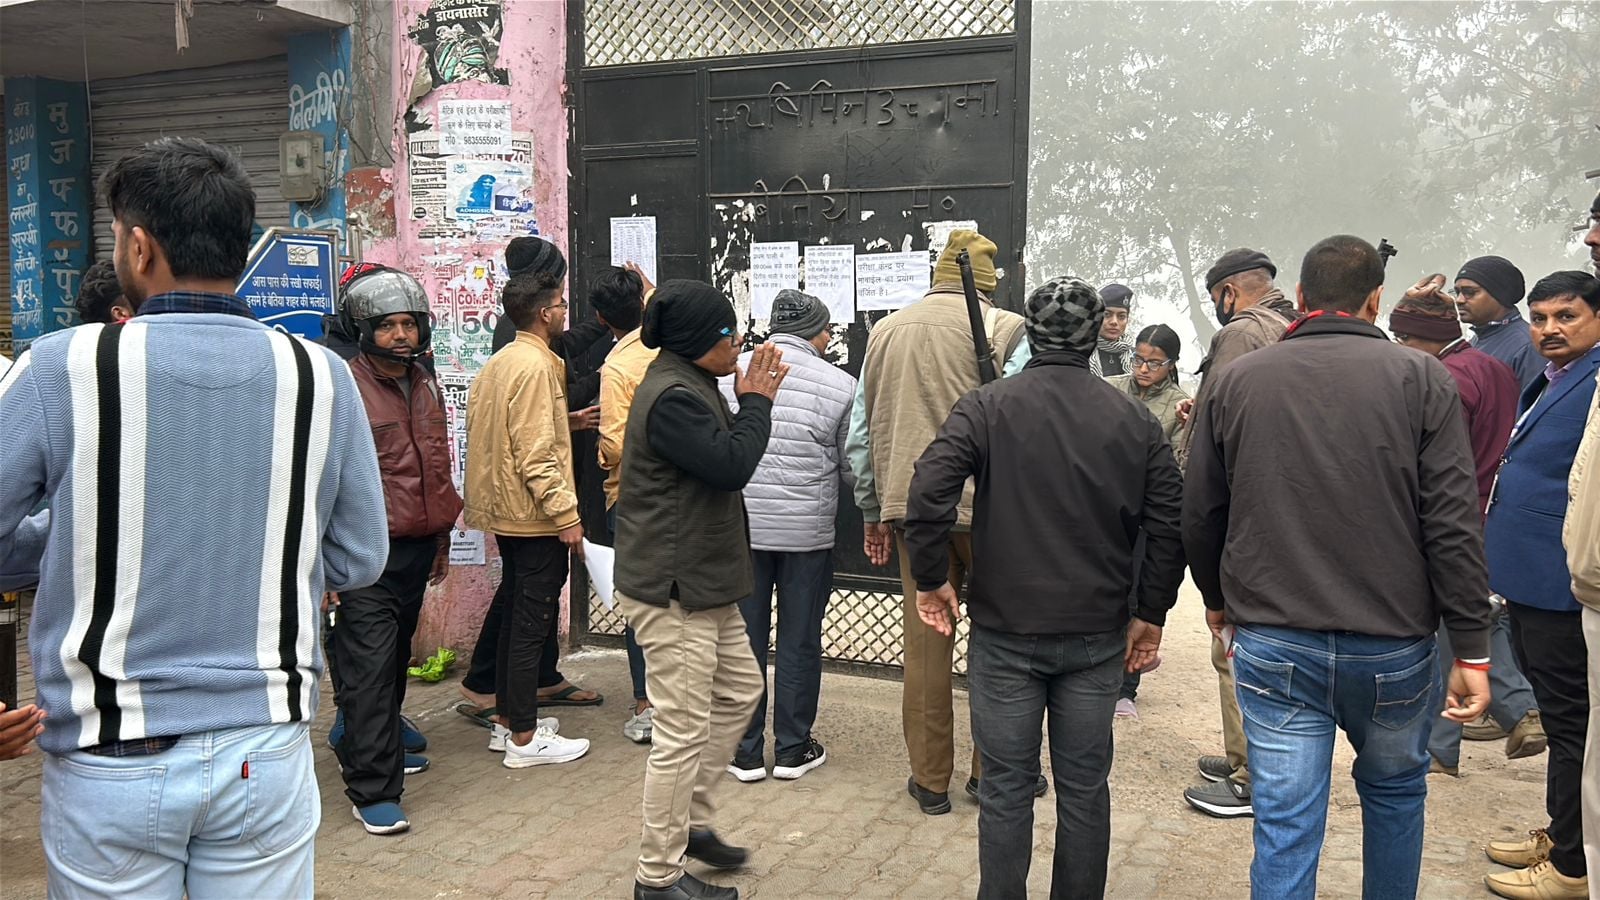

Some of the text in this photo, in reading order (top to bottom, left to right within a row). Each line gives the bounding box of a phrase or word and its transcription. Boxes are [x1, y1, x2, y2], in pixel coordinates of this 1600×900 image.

[434, 5, 489, 22] डायनासोर
[463, 136, 502, 145] 9835555091
[896, 261, 905, 270] पर
[252, 275, 266, 288] आस
[266, 276, 280, 289] पास
[280, 273, 289, 289] की
[267, 291, 285, 308] बेतिया
[285, 295, 299, 309] शहर
[299, 292, 309, 308] की
